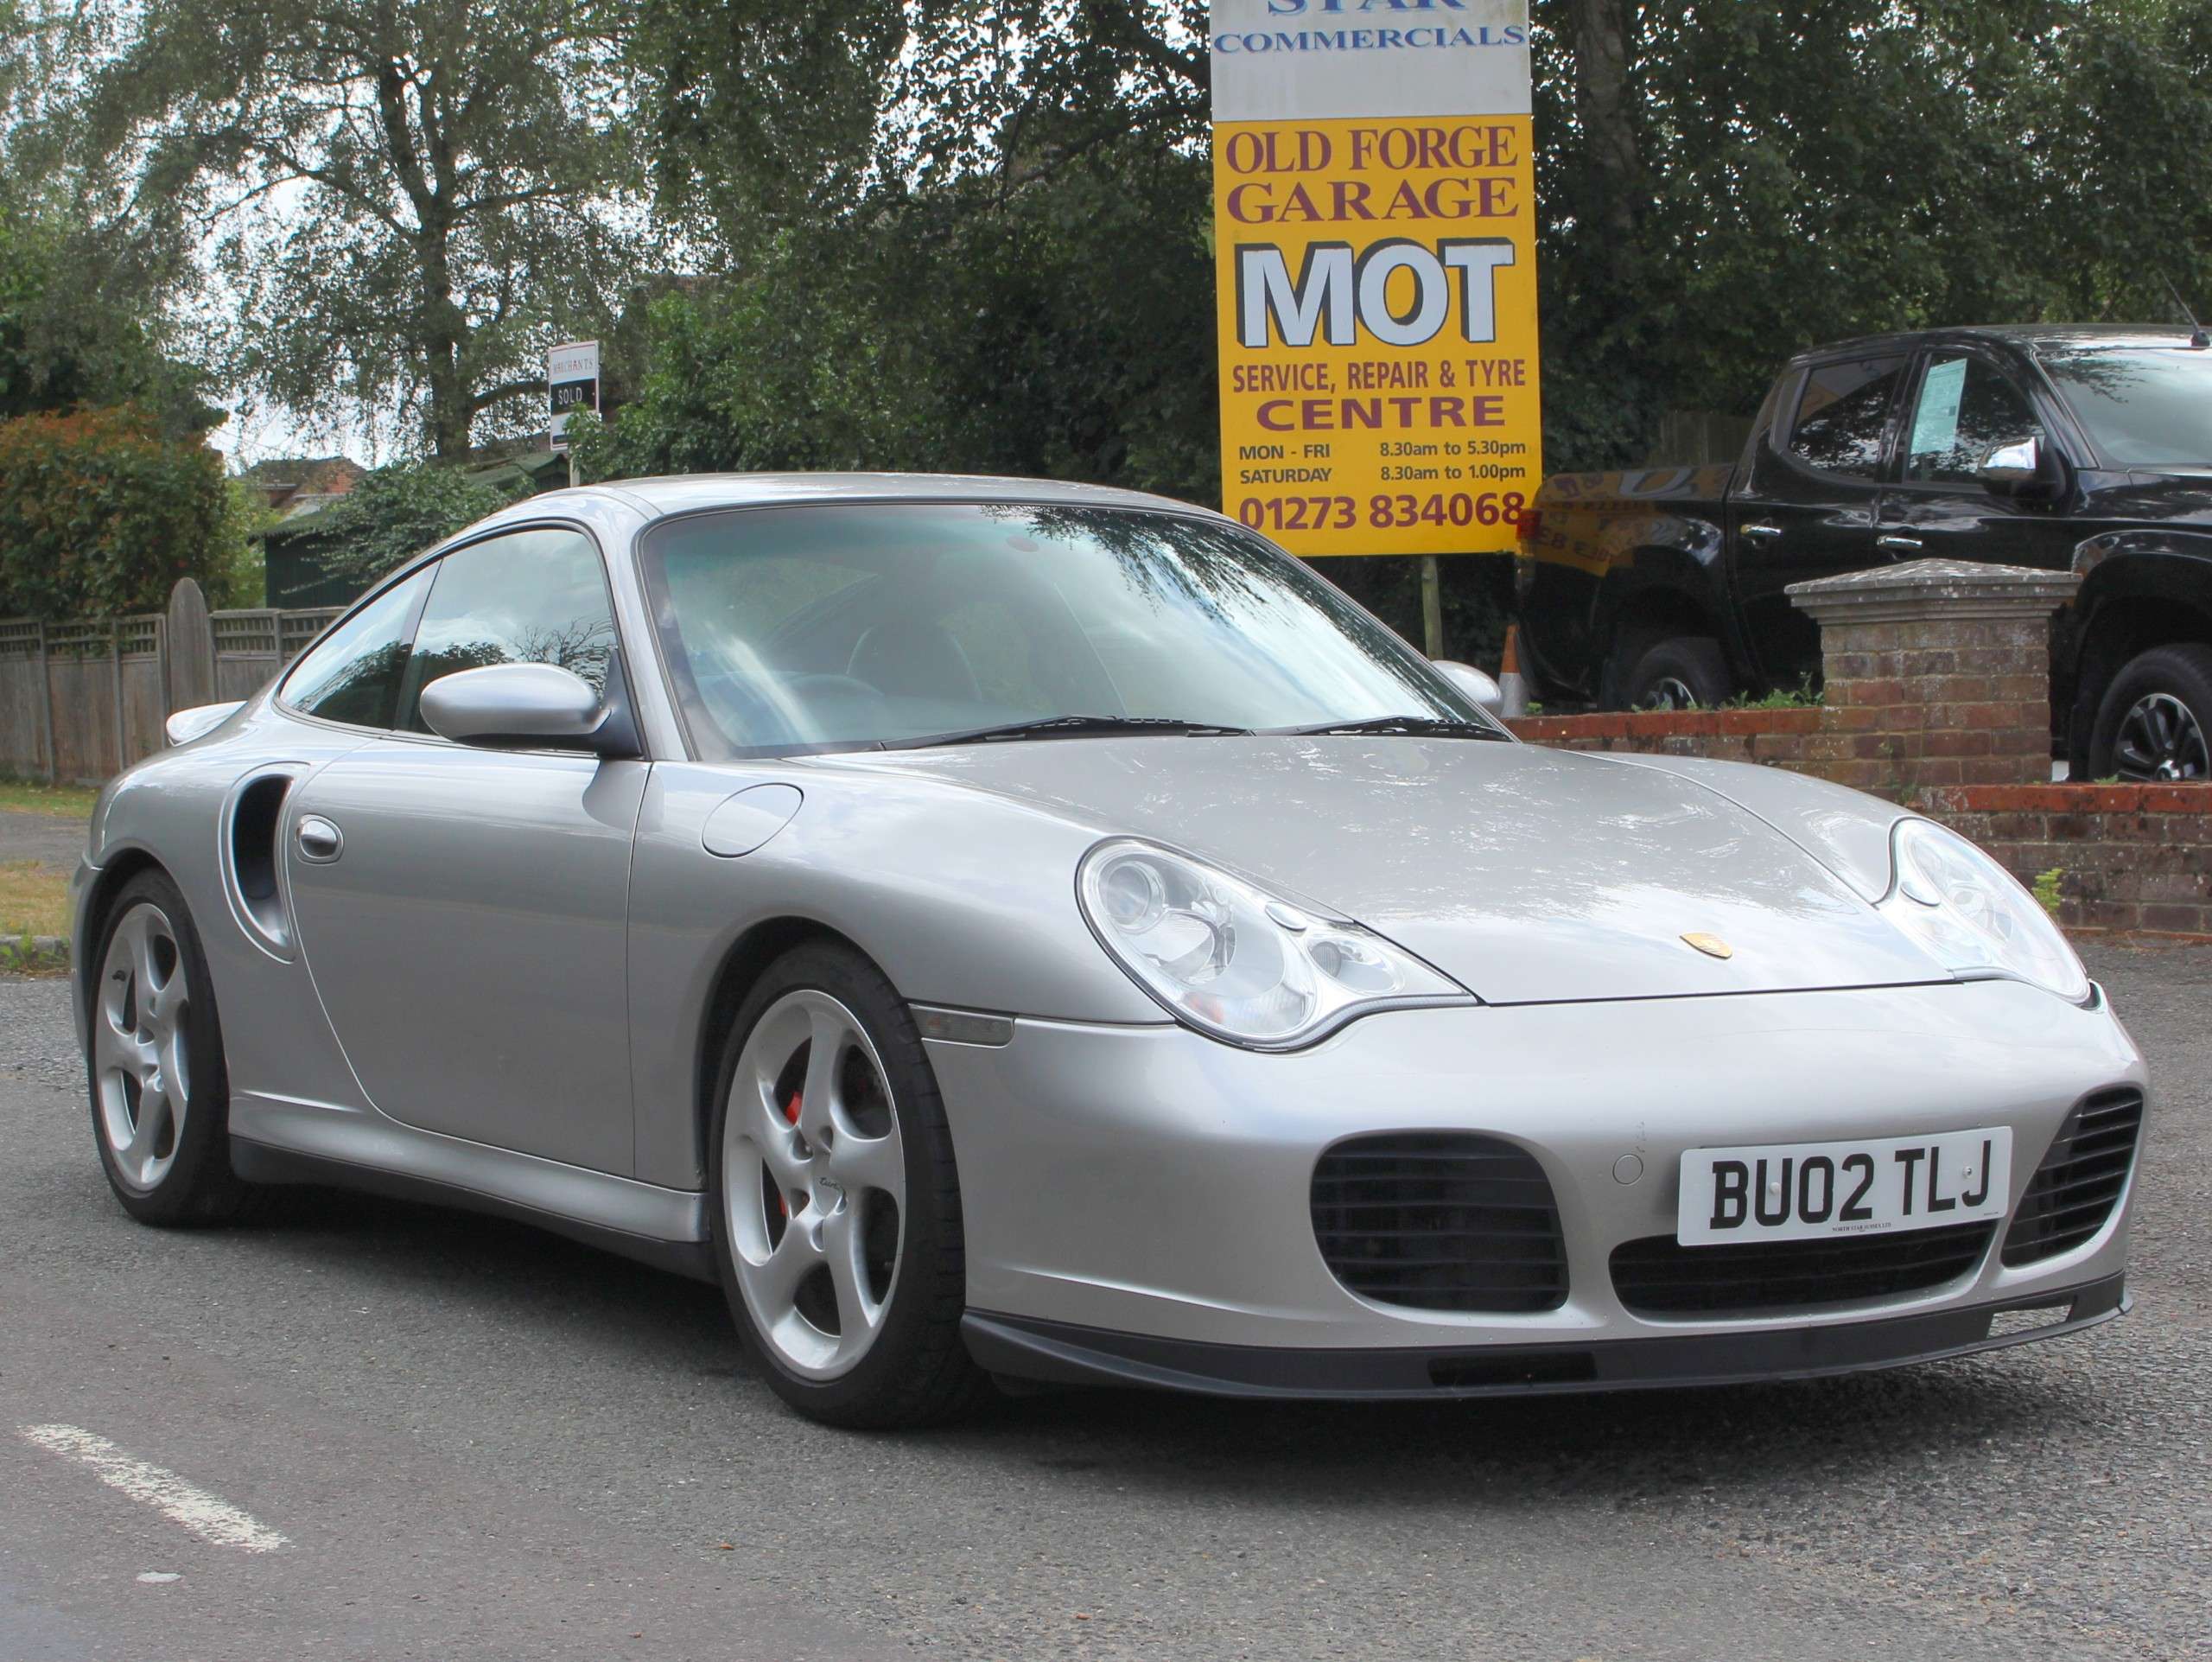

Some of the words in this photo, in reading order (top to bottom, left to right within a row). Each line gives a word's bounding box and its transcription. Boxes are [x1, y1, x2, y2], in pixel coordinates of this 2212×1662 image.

[1214, 25, 1525, 54] COMMERCIALS
[1226, 130, 1332, 174] OLD
[1348, 125, 1518, 170] FORGE
[1227, 177, 1519, 224] GARAGE
[1235, 237, 1515, 348] MOT
[1233, 363, 1337, 393] SERVICE,
[1348, 360, 1428, 390] REPAIR
[1440, 360, 1456, 387] &
[1465, 359, 1526, 387] TYRE
[558, 387, 583, 405] SOLD
[1256, 395, 1505, 431] CENTRE
[1239, 445, 1284, 460] MON
[1304, 444, 1331, 458] FRI
[1380, 442, 1438, 456] 8.30am
[1444, 442, 1461, 455] to
[1467, 441, 1526, 457] 5.30pm
[1240, 468, 1332, 484] SATURDAY
[1381, 465, 1439, 481] 8.30am
[1445, 466, 1462, 480] to
[1469, 464, 1525, 481] 1.00pm
[1239, 496, 1356, 531] 01273
[1370, 492, 1525, 529] 834068
[1709, 1153, 1874, 1230] BU02
[1895, 1140, 1992, 1216] TLJ
